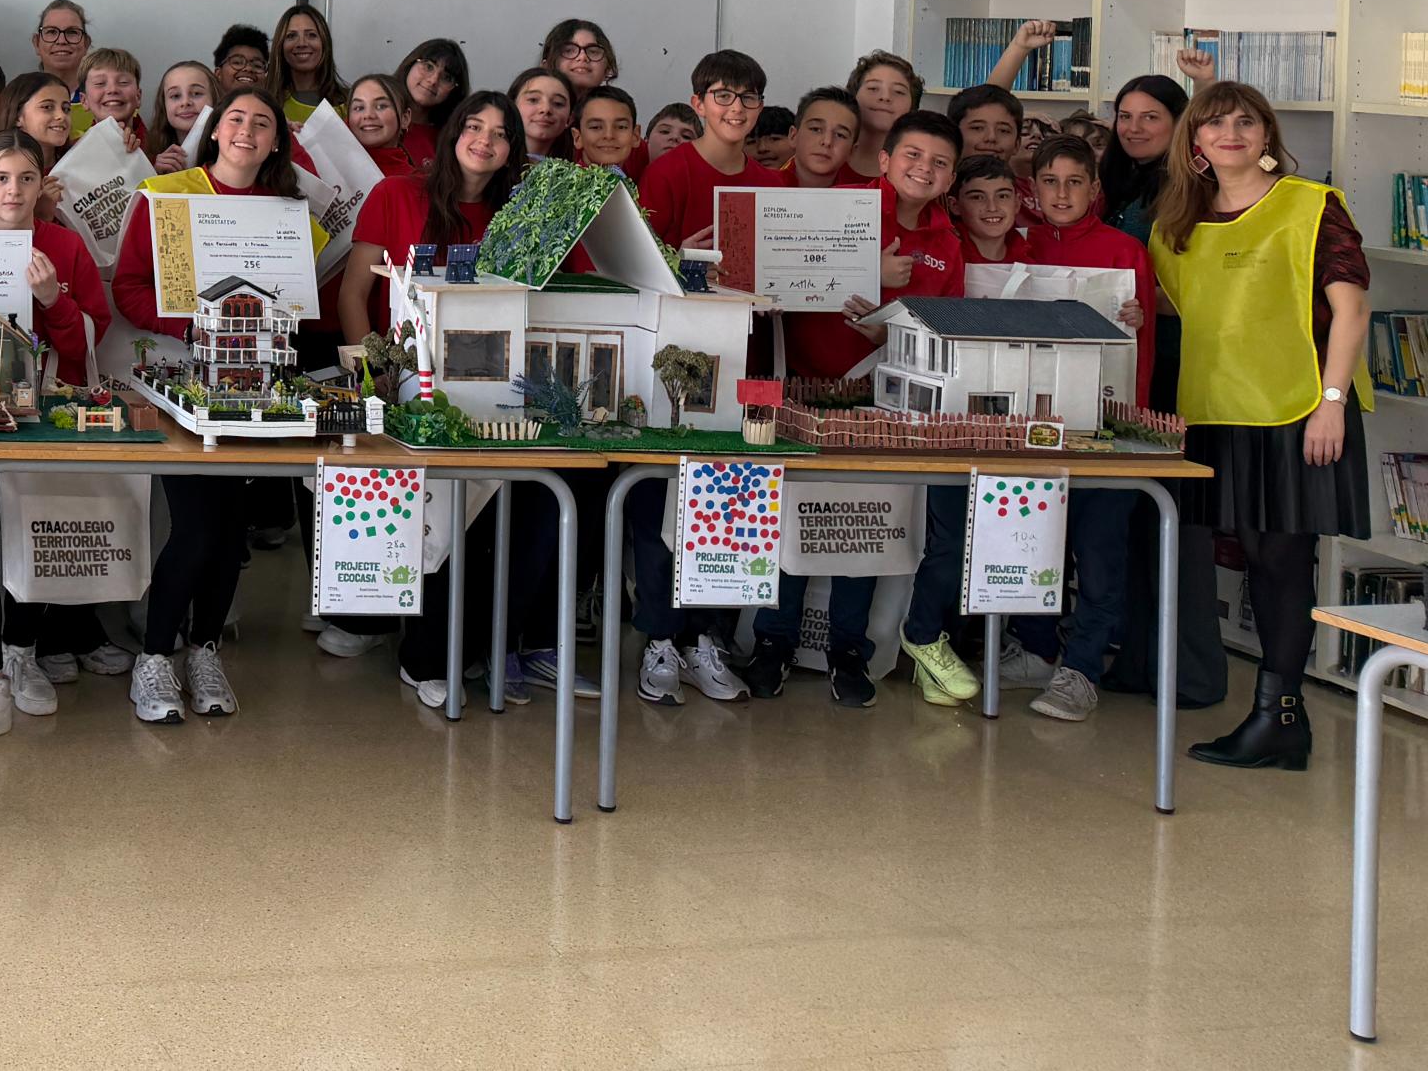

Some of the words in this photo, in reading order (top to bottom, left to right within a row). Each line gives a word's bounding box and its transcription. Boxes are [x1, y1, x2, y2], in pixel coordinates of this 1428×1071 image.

[803, 254, 827, 263] 100€
[924, 255, 946, 271] SDS
[244, 261, 261, 269] 25€
[798, 515, 888, 527] TERRITORIAL
[800, 527, 906, 542] DEARQUITECTOS
[32, 535, 111, 548] TERRITORIAL
[800, 541, 884, 554] DEALICANTE
[33, 548, 132, 564] DEARQUITECTOS
[695, 552, 739, 562] PROJECTE
[34, 564, 108, 577] DEALICANTE
[335, 561, 380, 571] PROJECTE
[698, 564, 735, 574] ECOCASA
[984, 564, 1028, 574] PROJECTE
[338, 573, 377, 583] ECOCASA
[987, 576, 1023, 585] ECOCASA
